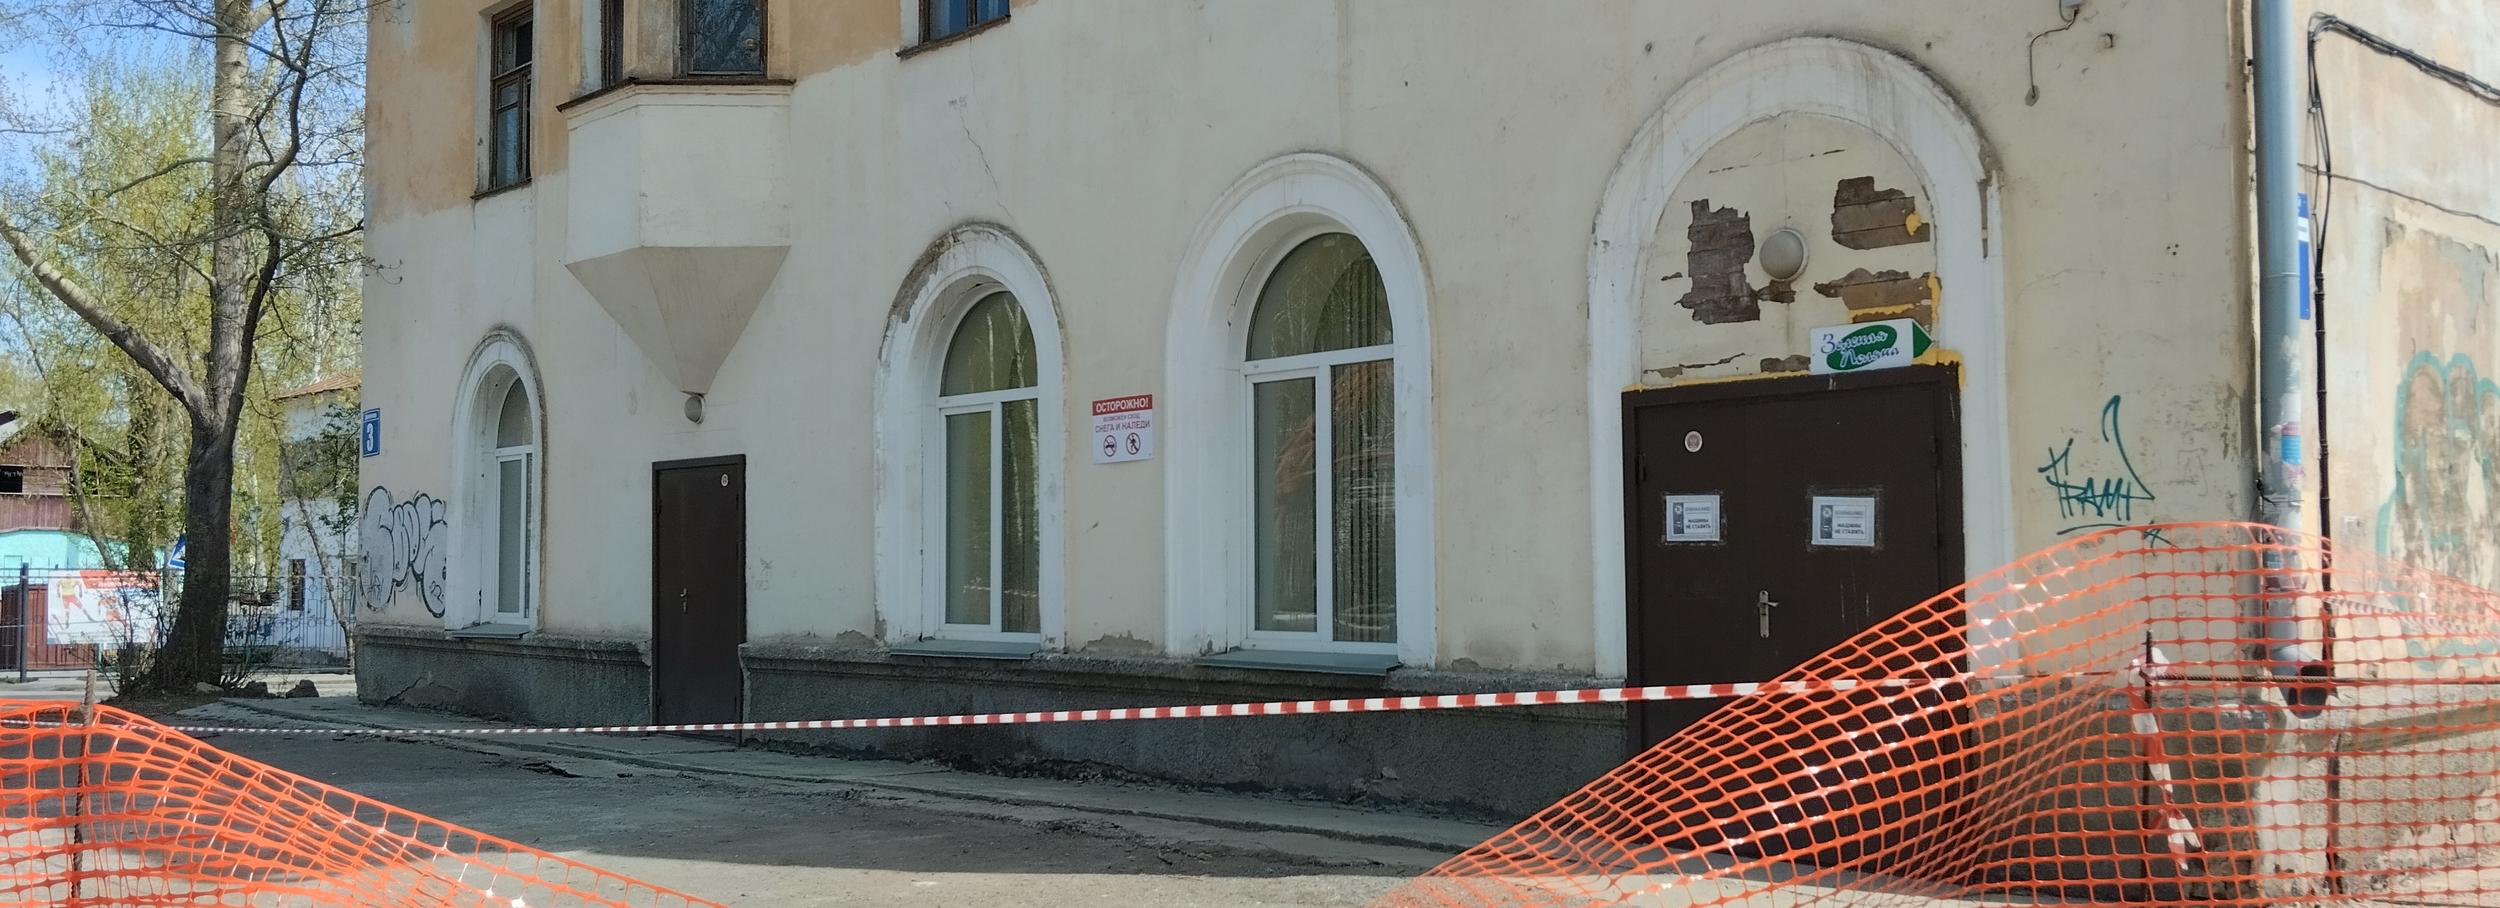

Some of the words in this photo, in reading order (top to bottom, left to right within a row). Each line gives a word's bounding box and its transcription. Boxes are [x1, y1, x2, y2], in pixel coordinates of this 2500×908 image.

[1839, 347, 1900, 368] Поляна
[1095, 397, 1149, 413] ОСТОРОЖНО!
[1095, 424, 1115, 433] СНЕГА
[1121, 420, 1150, 431] НАЛЕДИ
[366, 423, 374, 452] 3
